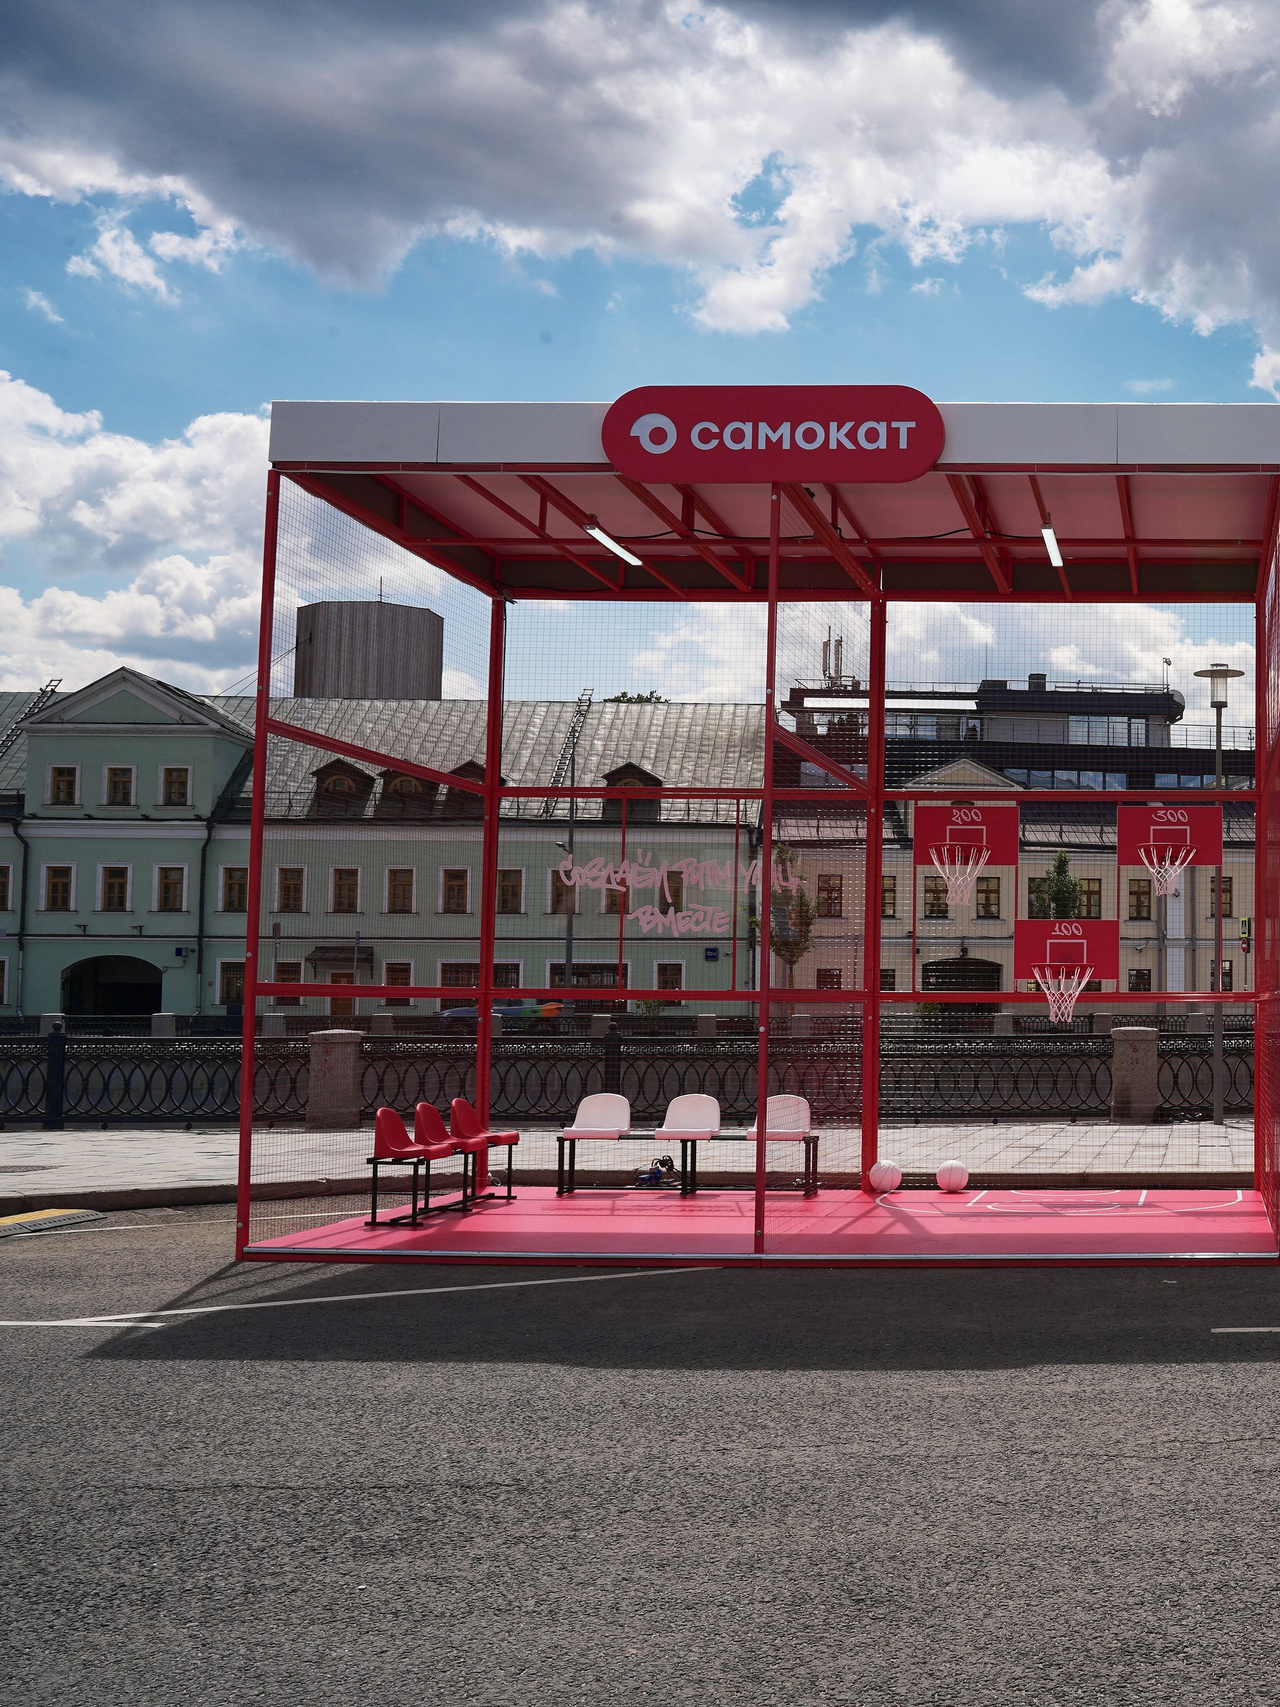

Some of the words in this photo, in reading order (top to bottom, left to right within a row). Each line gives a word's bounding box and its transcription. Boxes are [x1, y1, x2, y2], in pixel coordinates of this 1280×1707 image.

[690, 420, 916, 450] самокат
[951, 808, 982, 824] 200
[1152, 809, 1189, 823] 300
[1051, 922, 1083, 936] 100
